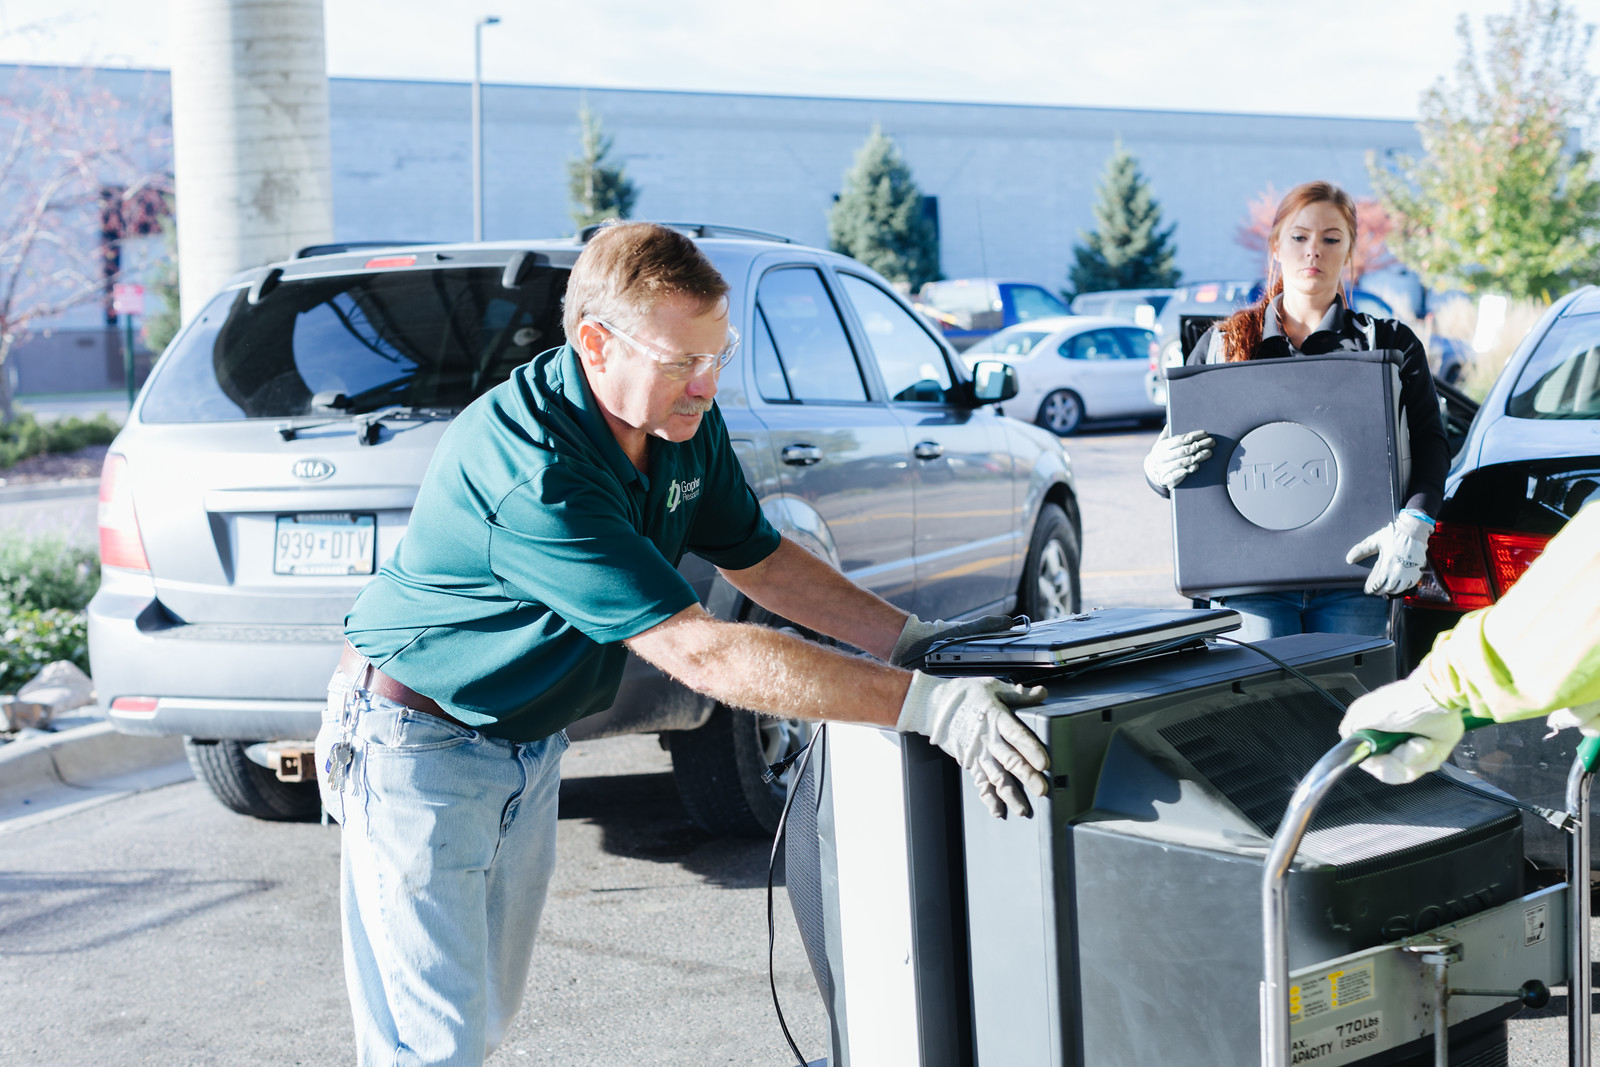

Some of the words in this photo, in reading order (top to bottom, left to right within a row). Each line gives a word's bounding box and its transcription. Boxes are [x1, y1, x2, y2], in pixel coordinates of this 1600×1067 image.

[295, 462, 326, 478] KIA
[1236, 459, 1329, 491] DELL
[279, 532, 315, 559] 939
[331, 531, 368, 559] DTV
[1381, 882, 1501, 942] SONY
[1291, 1039, 1308, 1051] AX.
[1291, 1041, 1333, 1065] APACITY
